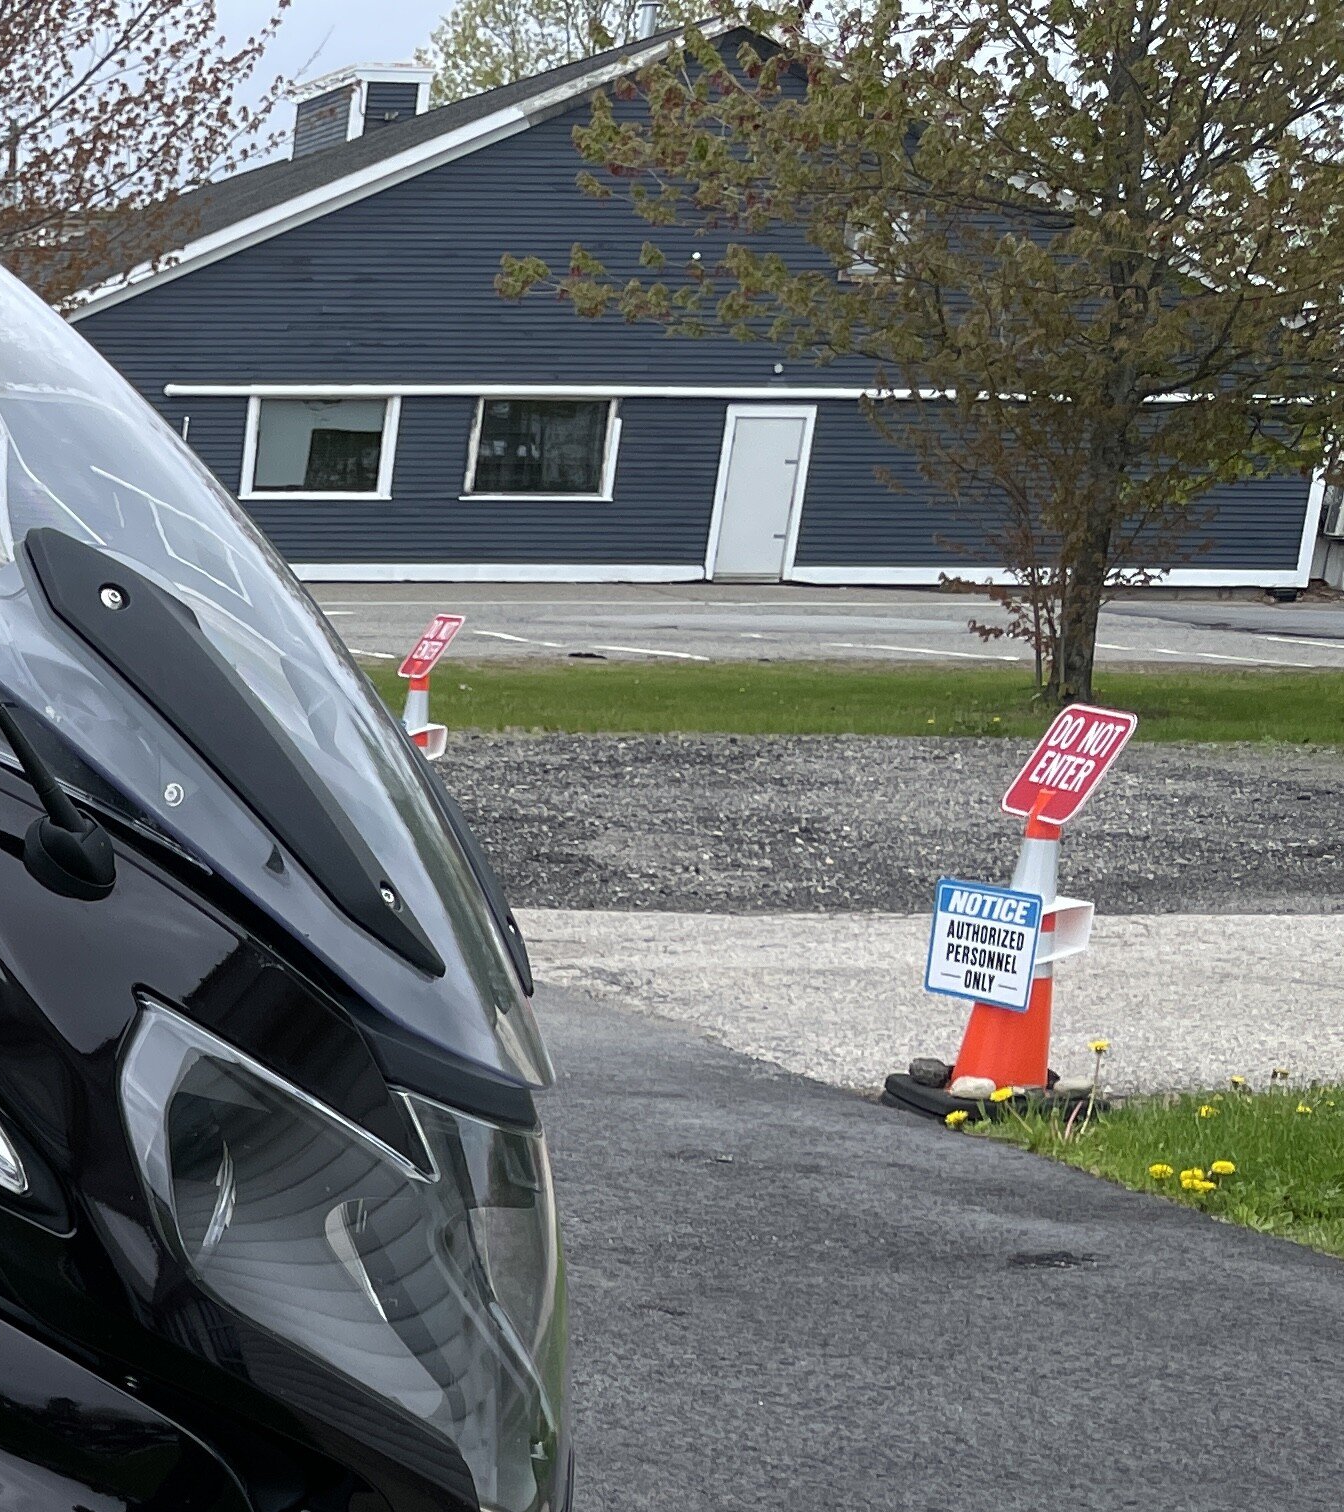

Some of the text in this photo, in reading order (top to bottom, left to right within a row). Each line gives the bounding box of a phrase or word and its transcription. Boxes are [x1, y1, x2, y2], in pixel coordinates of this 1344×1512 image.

[1048, 714, 1125, 759] DO NOT
[1028, 753, 1096, 793] ENTER
[947, 889, 1032, 925] NOTICE
[946, 919, 1025, 952] AUTHORIZED
[945, 943, 1018, 975] PERSONNEL
[964, 969, 996, 994] ONLY
